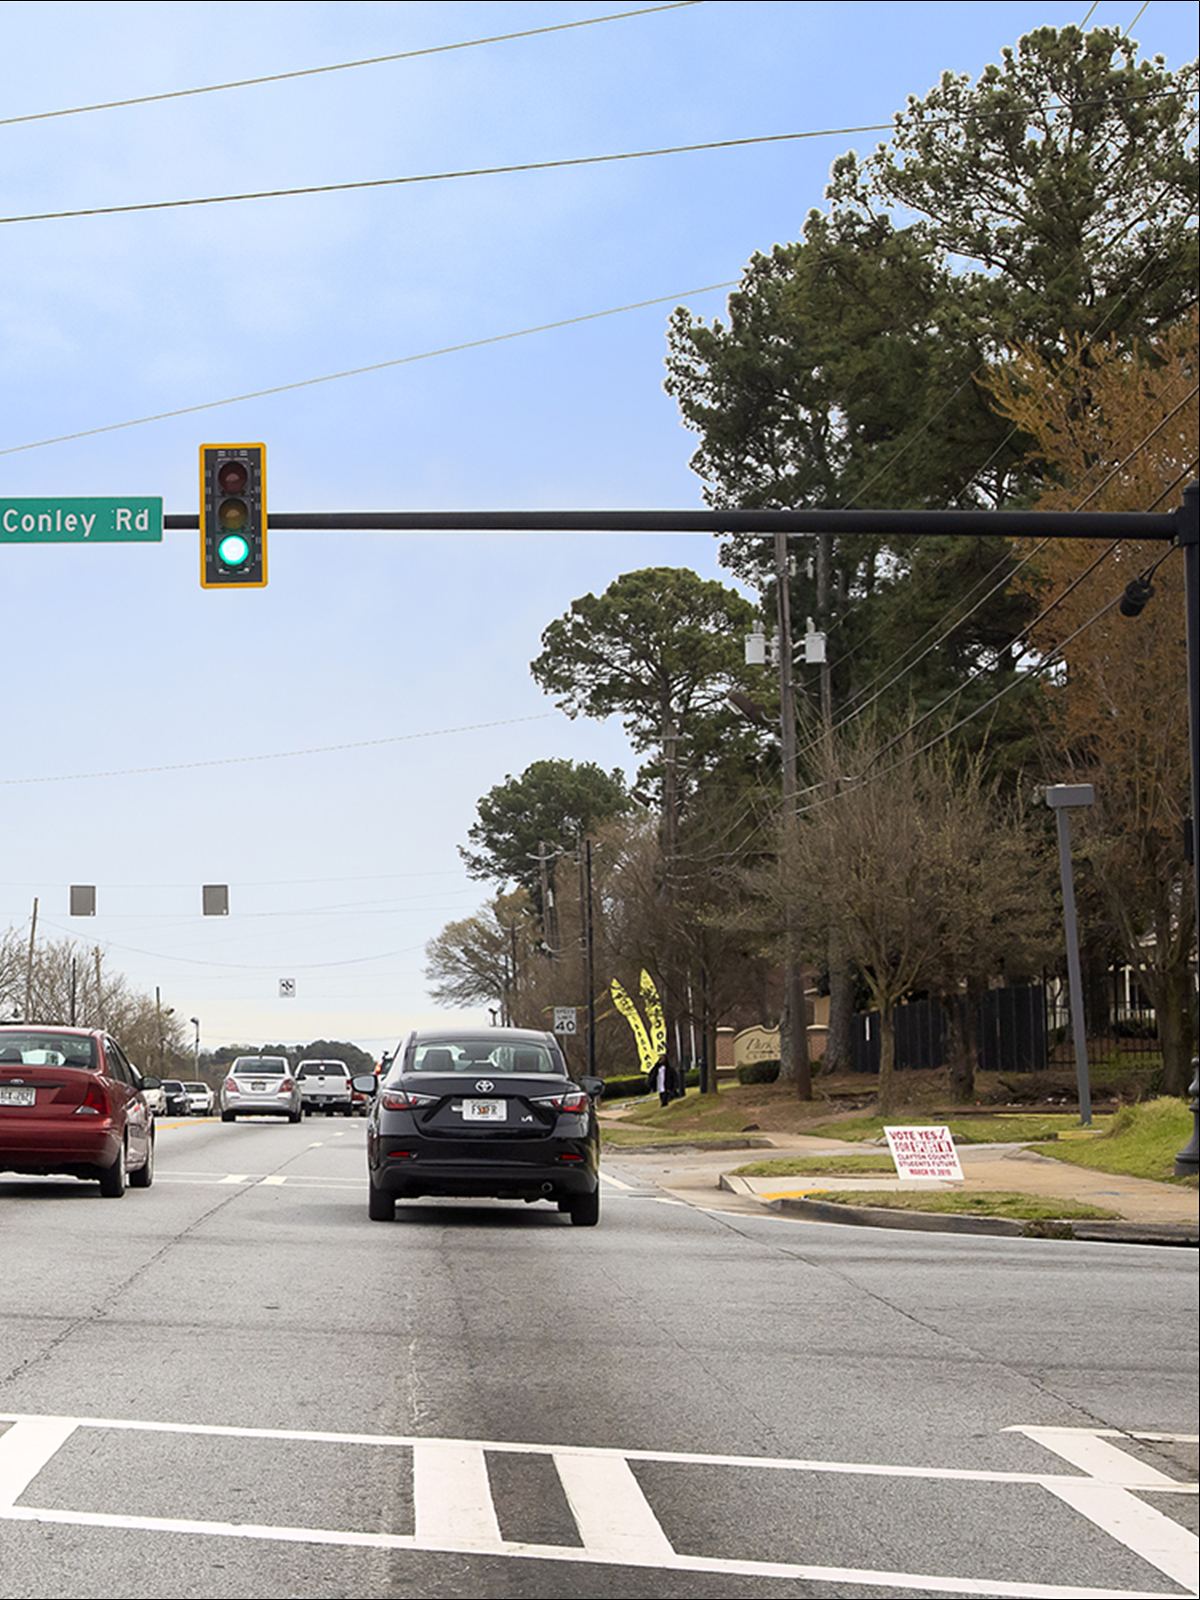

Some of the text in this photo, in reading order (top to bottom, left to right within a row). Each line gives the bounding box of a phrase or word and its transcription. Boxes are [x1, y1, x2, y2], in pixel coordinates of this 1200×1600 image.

[3, 507, 149, 537] Conley Rd
[555, 1020, 575, 1031] 40
[888, 1130, 938, 1140] VOTE YES
[894, 1141, 911, 1152] FOR
